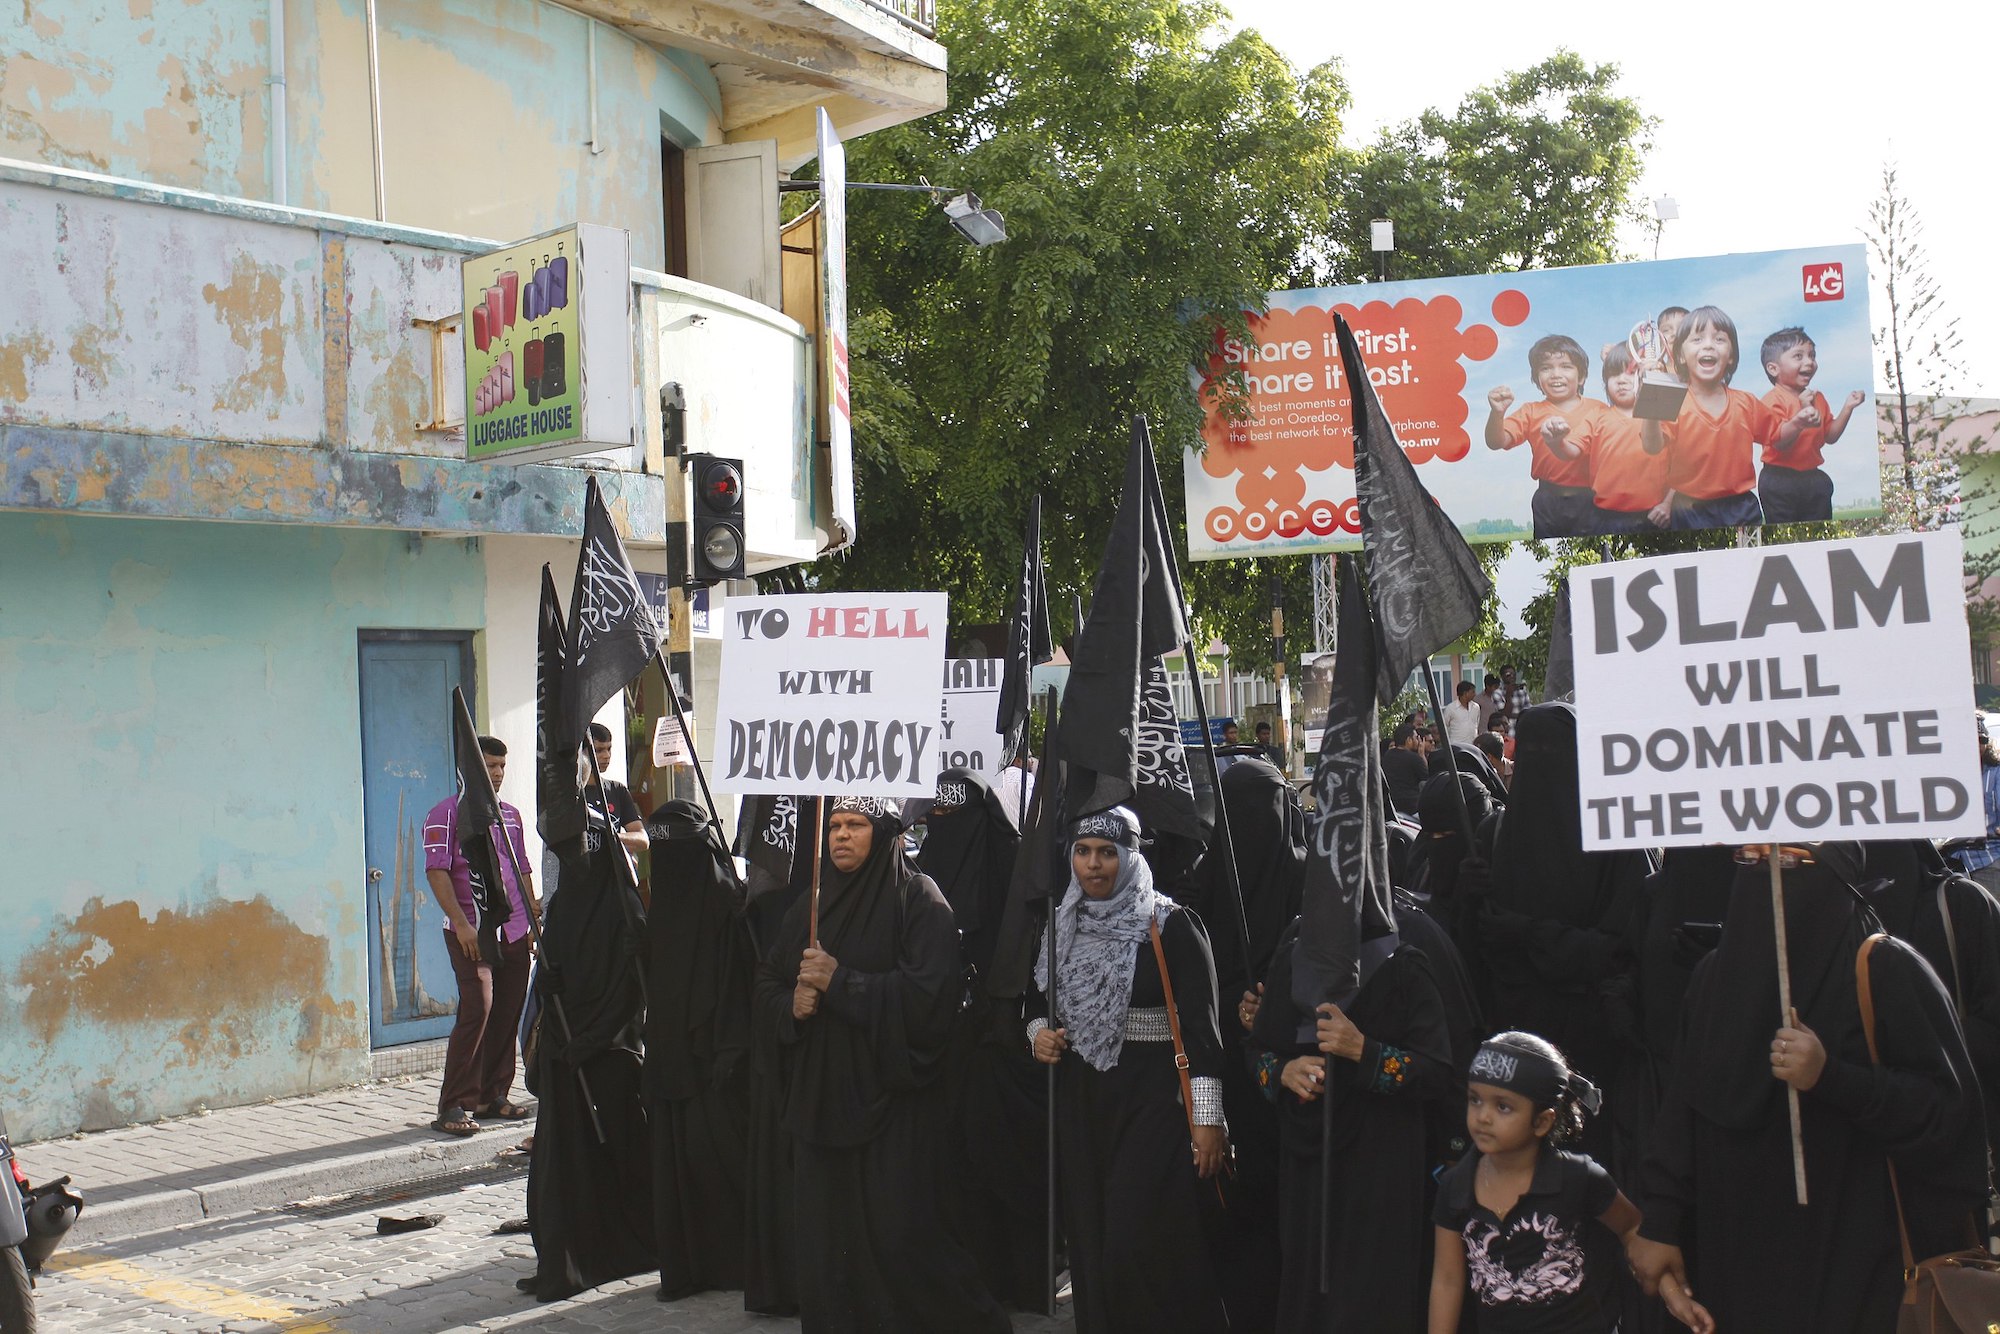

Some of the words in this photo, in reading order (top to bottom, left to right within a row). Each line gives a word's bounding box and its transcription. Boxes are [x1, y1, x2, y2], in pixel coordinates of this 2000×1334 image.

[1805, 266, 1843, 296] 4G
[1223, 340, 1313, 364] Share
[1322, 332, 1339, 357] it
[1324, 364, 1343, 390] it
[1363, 359, 1420, 387] ast.
[1229, 414, 1267, 429] shared
[1269, 417, 1284, 426] on
[1287, 410, 1344, 425] Ooredoo,
[1259, 401, 1281, 412] best
[1285, 398, 1336, 410] moments
[474, 413, 528, 447] LUGGAGE
[530, 404, 573, 436] HOUSE
[1229, 430, 1247, 443] the
[1250, 429, 1272, 442] best
[1276, 424, 1320, 439] network
[1322, 423, 1339, 436] for
[1591, 540, 1931, 655] ISLAM
[736, 608, 790, 640] TO
[805, 606, 930, 640] HELL
[778, 669, 875, 695] WITH
[1685, 654, 1841, 706] WILL
[725, 718, 933, 785] DEMOCRACY
[1601, 709, 1943, 777] DOMINATE
[1587, 791, 1703, 841] THE
[1720, 776, 1970, 832] WORLD
